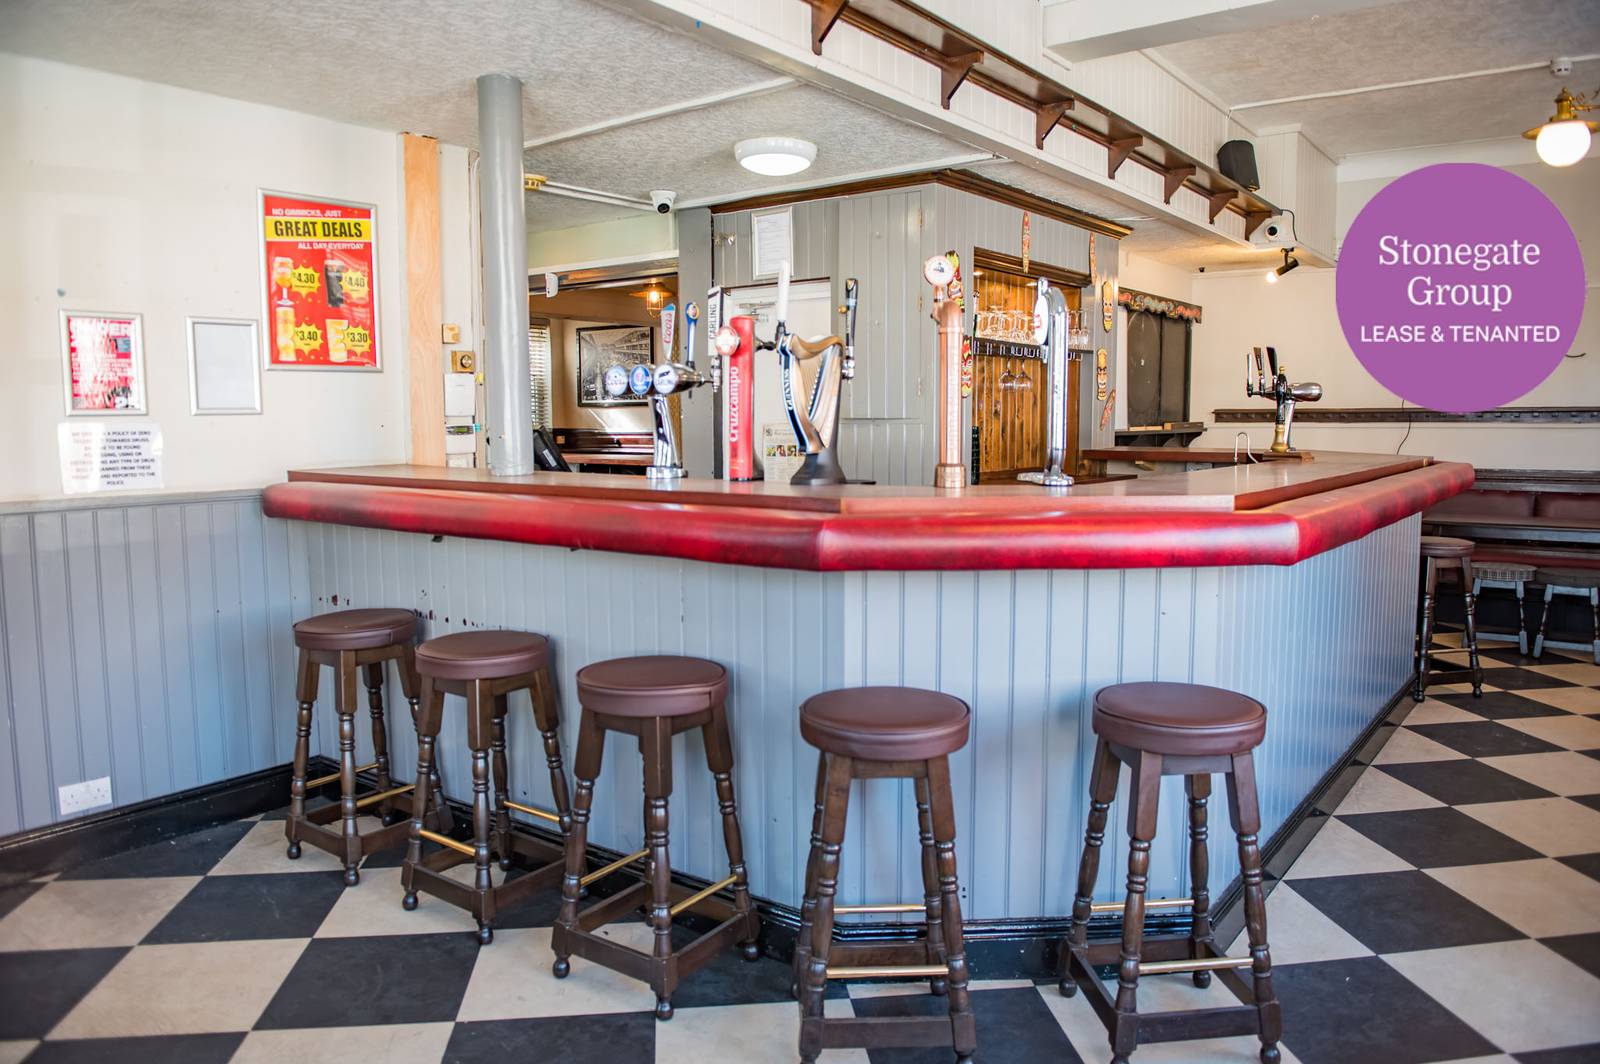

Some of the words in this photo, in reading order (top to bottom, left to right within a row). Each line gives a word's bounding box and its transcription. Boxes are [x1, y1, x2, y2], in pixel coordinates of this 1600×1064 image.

[271, 208, 284, 216] NO
[324, 209, 342, 217] JUST
[274, 220, 317, 237] GREAT
[321, 221, 363, 238] DEALS
[298, 242, 312, 250] ALL
[663, 312, 673, 344] Coors
[708, 303, 718, 340] CARLING
[728, 366, 741, 442] Cruzcampo
[783, 368, 793, 411] GUINNESS
